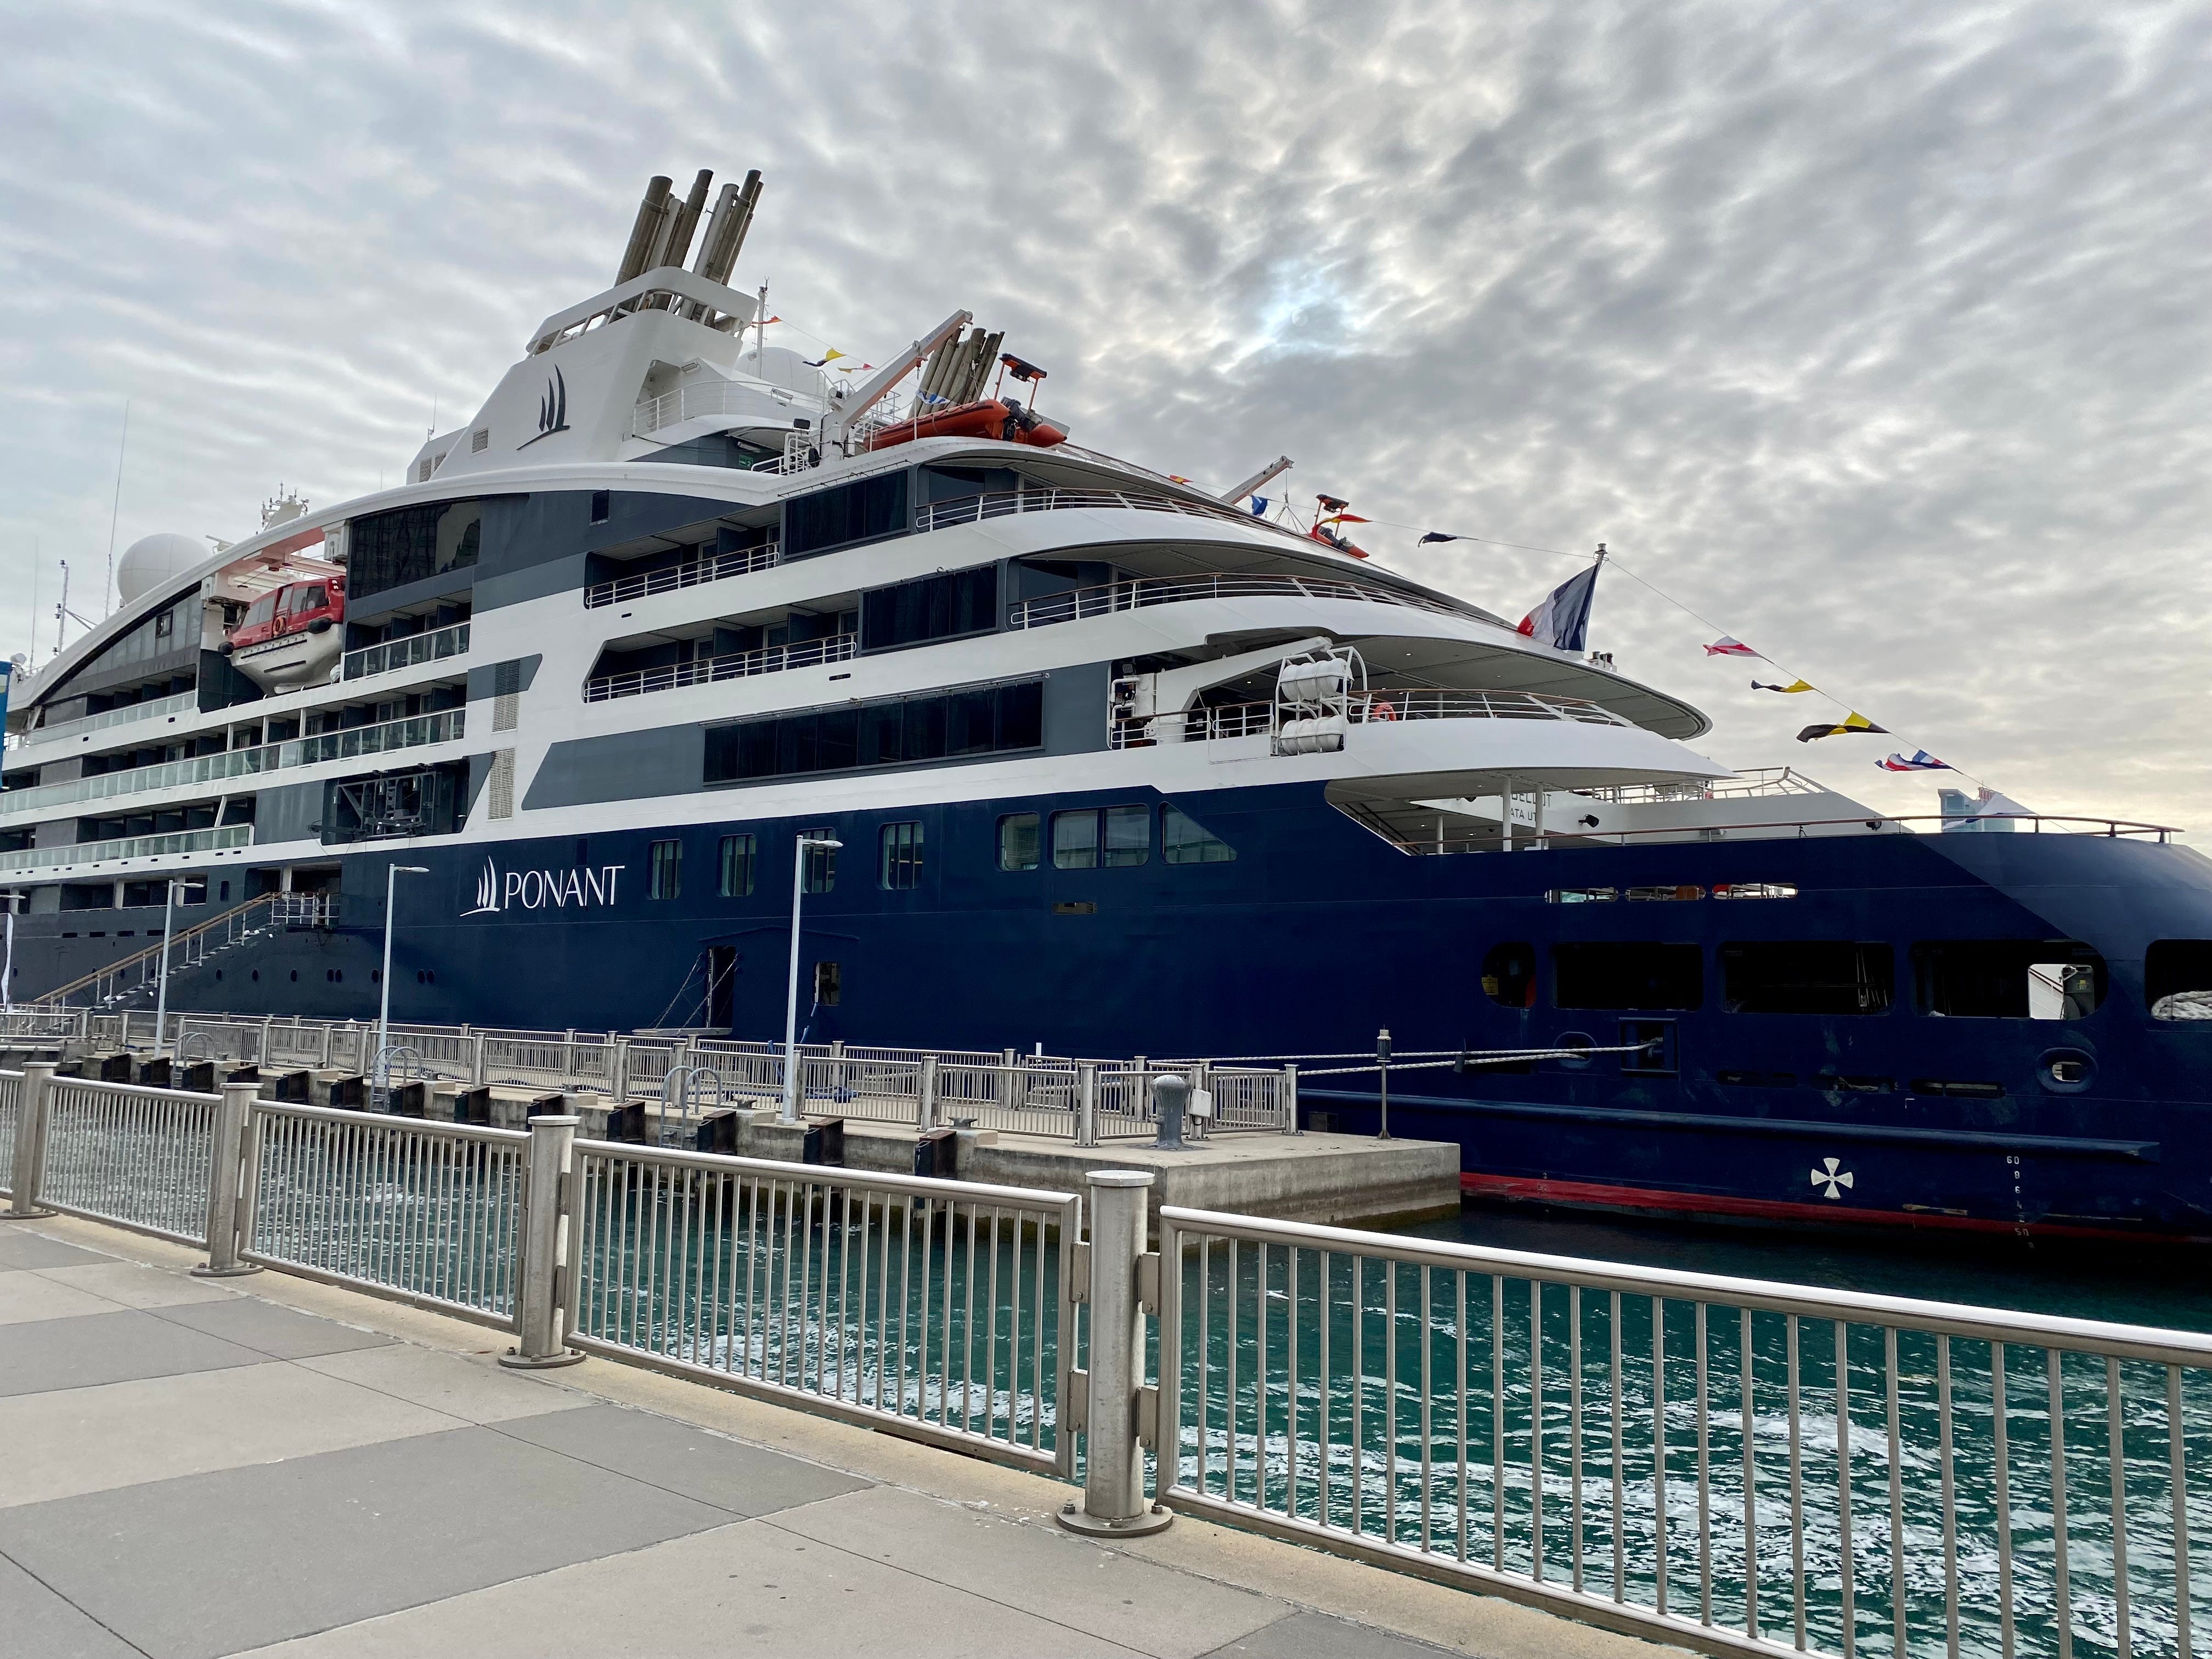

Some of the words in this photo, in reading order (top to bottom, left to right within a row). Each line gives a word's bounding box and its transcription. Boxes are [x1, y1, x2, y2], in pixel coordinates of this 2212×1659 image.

[1511, 808, 1524, 819] ATA
[505, 865, 625, 909] PONANT
[2007, 1156, 2019, 1165] 60
[2015, 1171, 2019, 1179] 8
